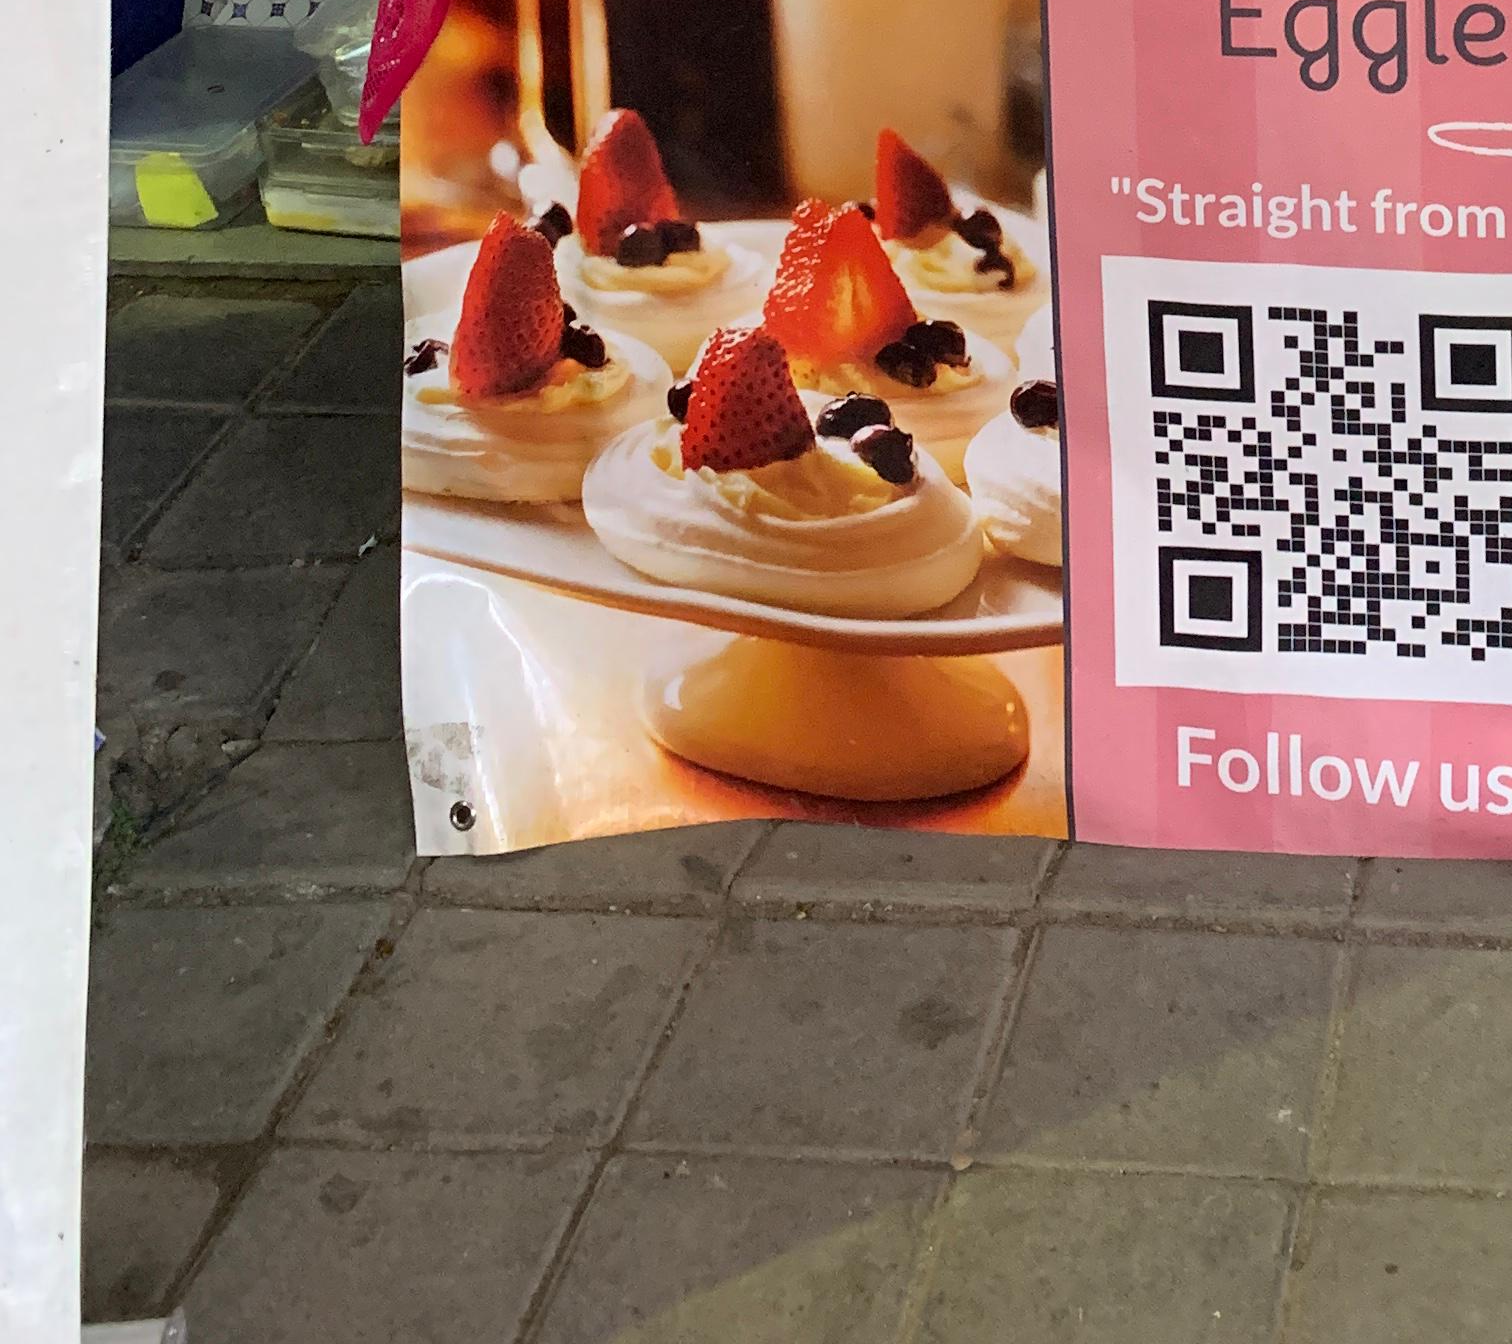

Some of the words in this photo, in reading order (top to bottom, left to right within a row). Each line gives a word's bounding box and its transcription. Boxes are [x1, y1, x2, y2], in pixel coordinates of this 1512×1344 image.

[1110, 176, 1358, 240] "Straight
[1371, 188, 1507, 240] from
[1177, 725, 1420, 808] Follow
